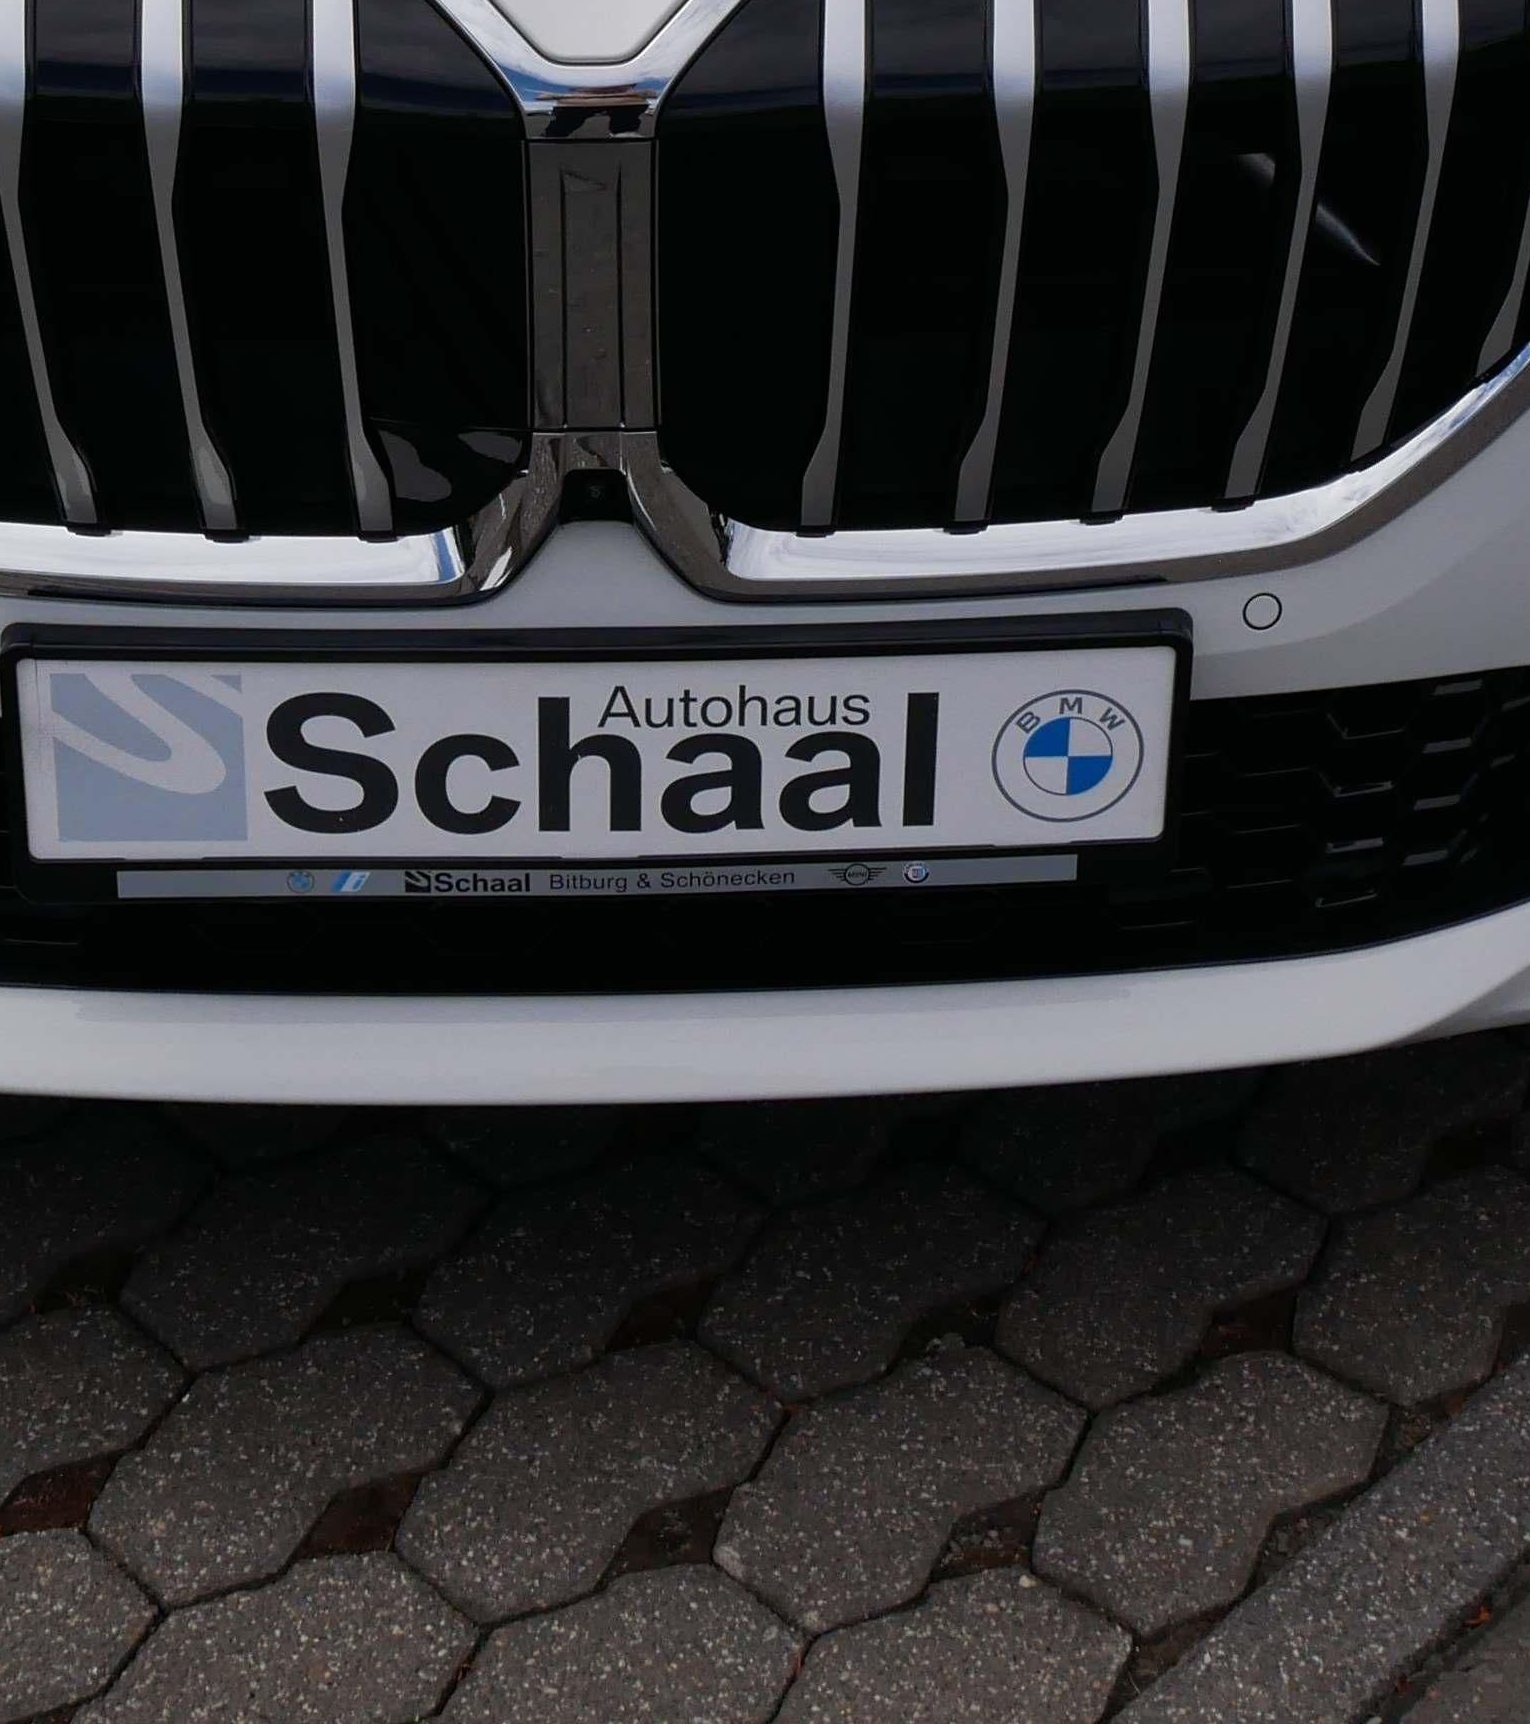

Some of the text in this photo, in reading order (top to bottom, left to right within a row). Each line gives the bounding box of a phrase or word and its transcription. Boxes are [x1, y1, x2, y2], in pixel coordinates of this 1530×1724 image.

[597, 684, 871, 729] Autohaus
[1015, 696, 1126, 735] BMW
[263, 691, 940, 835] Schaal
[434, 868, 795, 893] Schaal Bitburg & Schönecken
